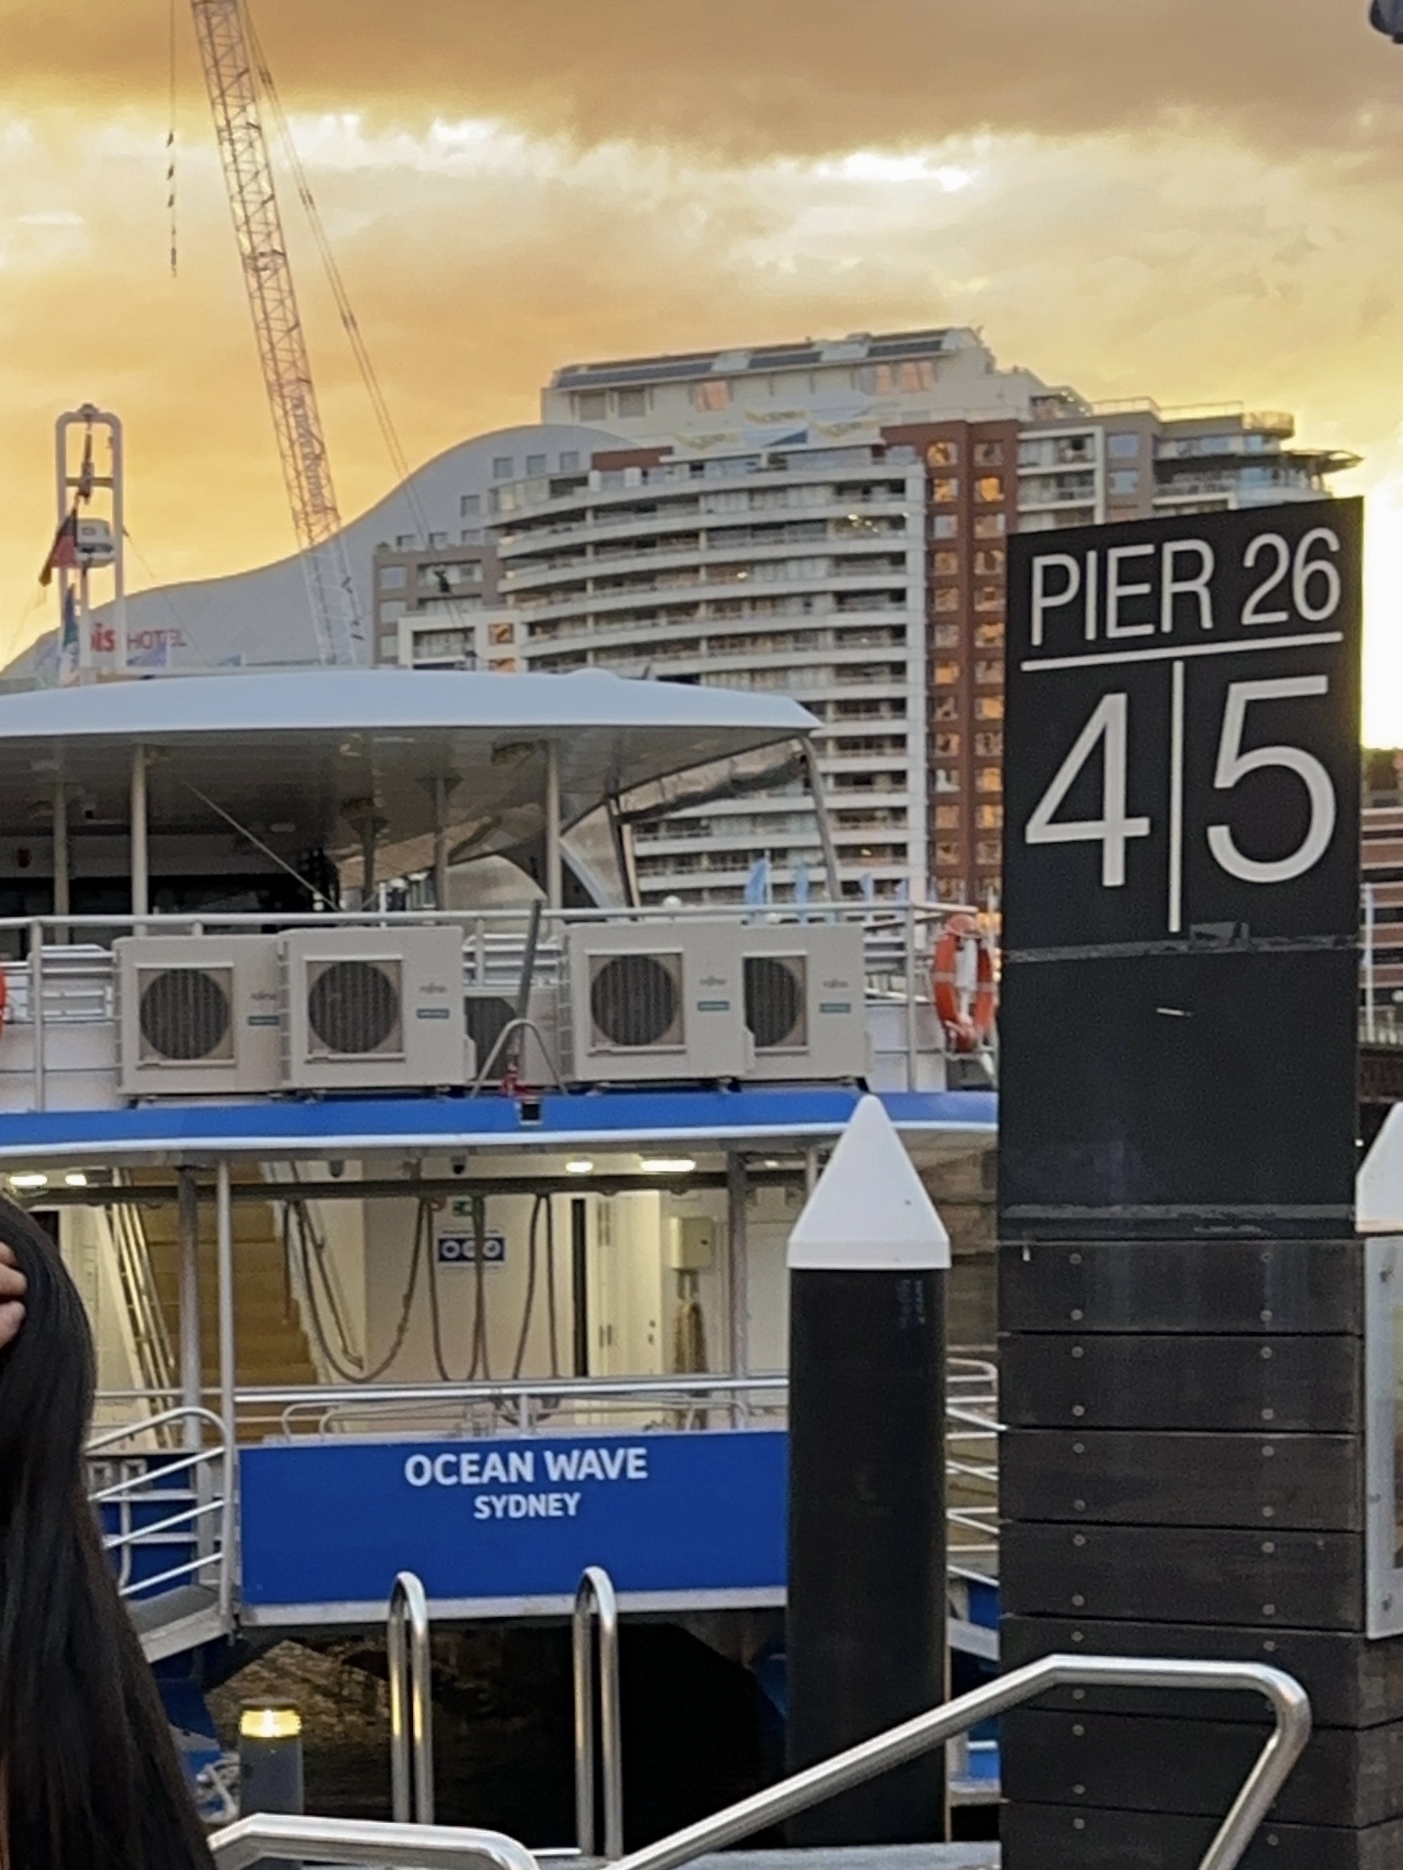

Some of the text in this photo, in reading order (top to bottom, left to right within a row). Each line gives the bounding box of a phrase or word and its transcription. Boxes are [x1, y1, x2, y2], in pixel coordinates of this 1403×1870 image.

[1031, 527, 1341, 646] PIER 26
[1025, 674, 1336, 887] 4 5
[404, 1447, 648, 1486] OCEAN WAVE
[472, 1492, 581, 1519] SYDNEY
